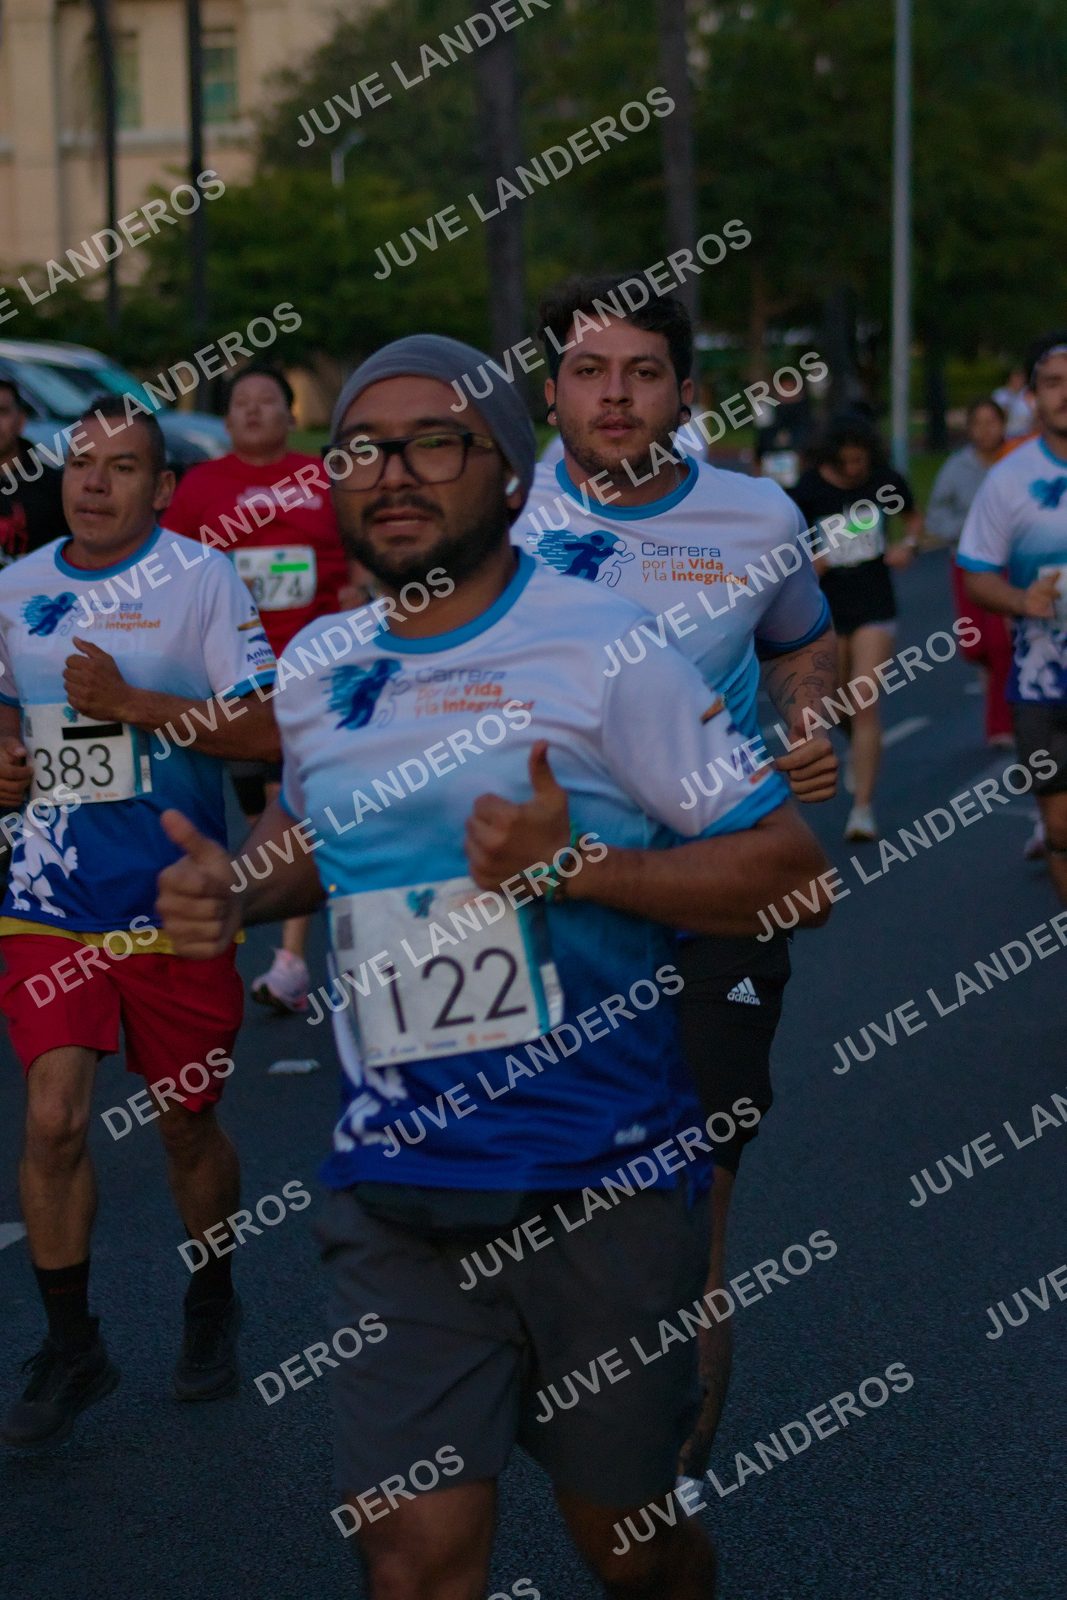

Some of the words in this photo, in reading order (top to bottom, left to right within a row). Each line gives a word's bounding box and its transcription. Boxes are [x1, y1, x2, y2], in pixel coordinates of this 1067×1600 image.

[641, 541, 721, 558] Carrera
[642, 559, 666, 575] por
[671, 558, 685, 570] la
[688, 558, 724, 572] Vida
[642, 572, 650, 583] y
[654, 569, 667, 581] la
[672, 570, 748, 586] Integridad
[415, 667, 507, 683] Carrera
[464, 682, 503, 697] Vida
[34, 744, 114, 791] 383
[727, 991, 760, 1006] adidas
